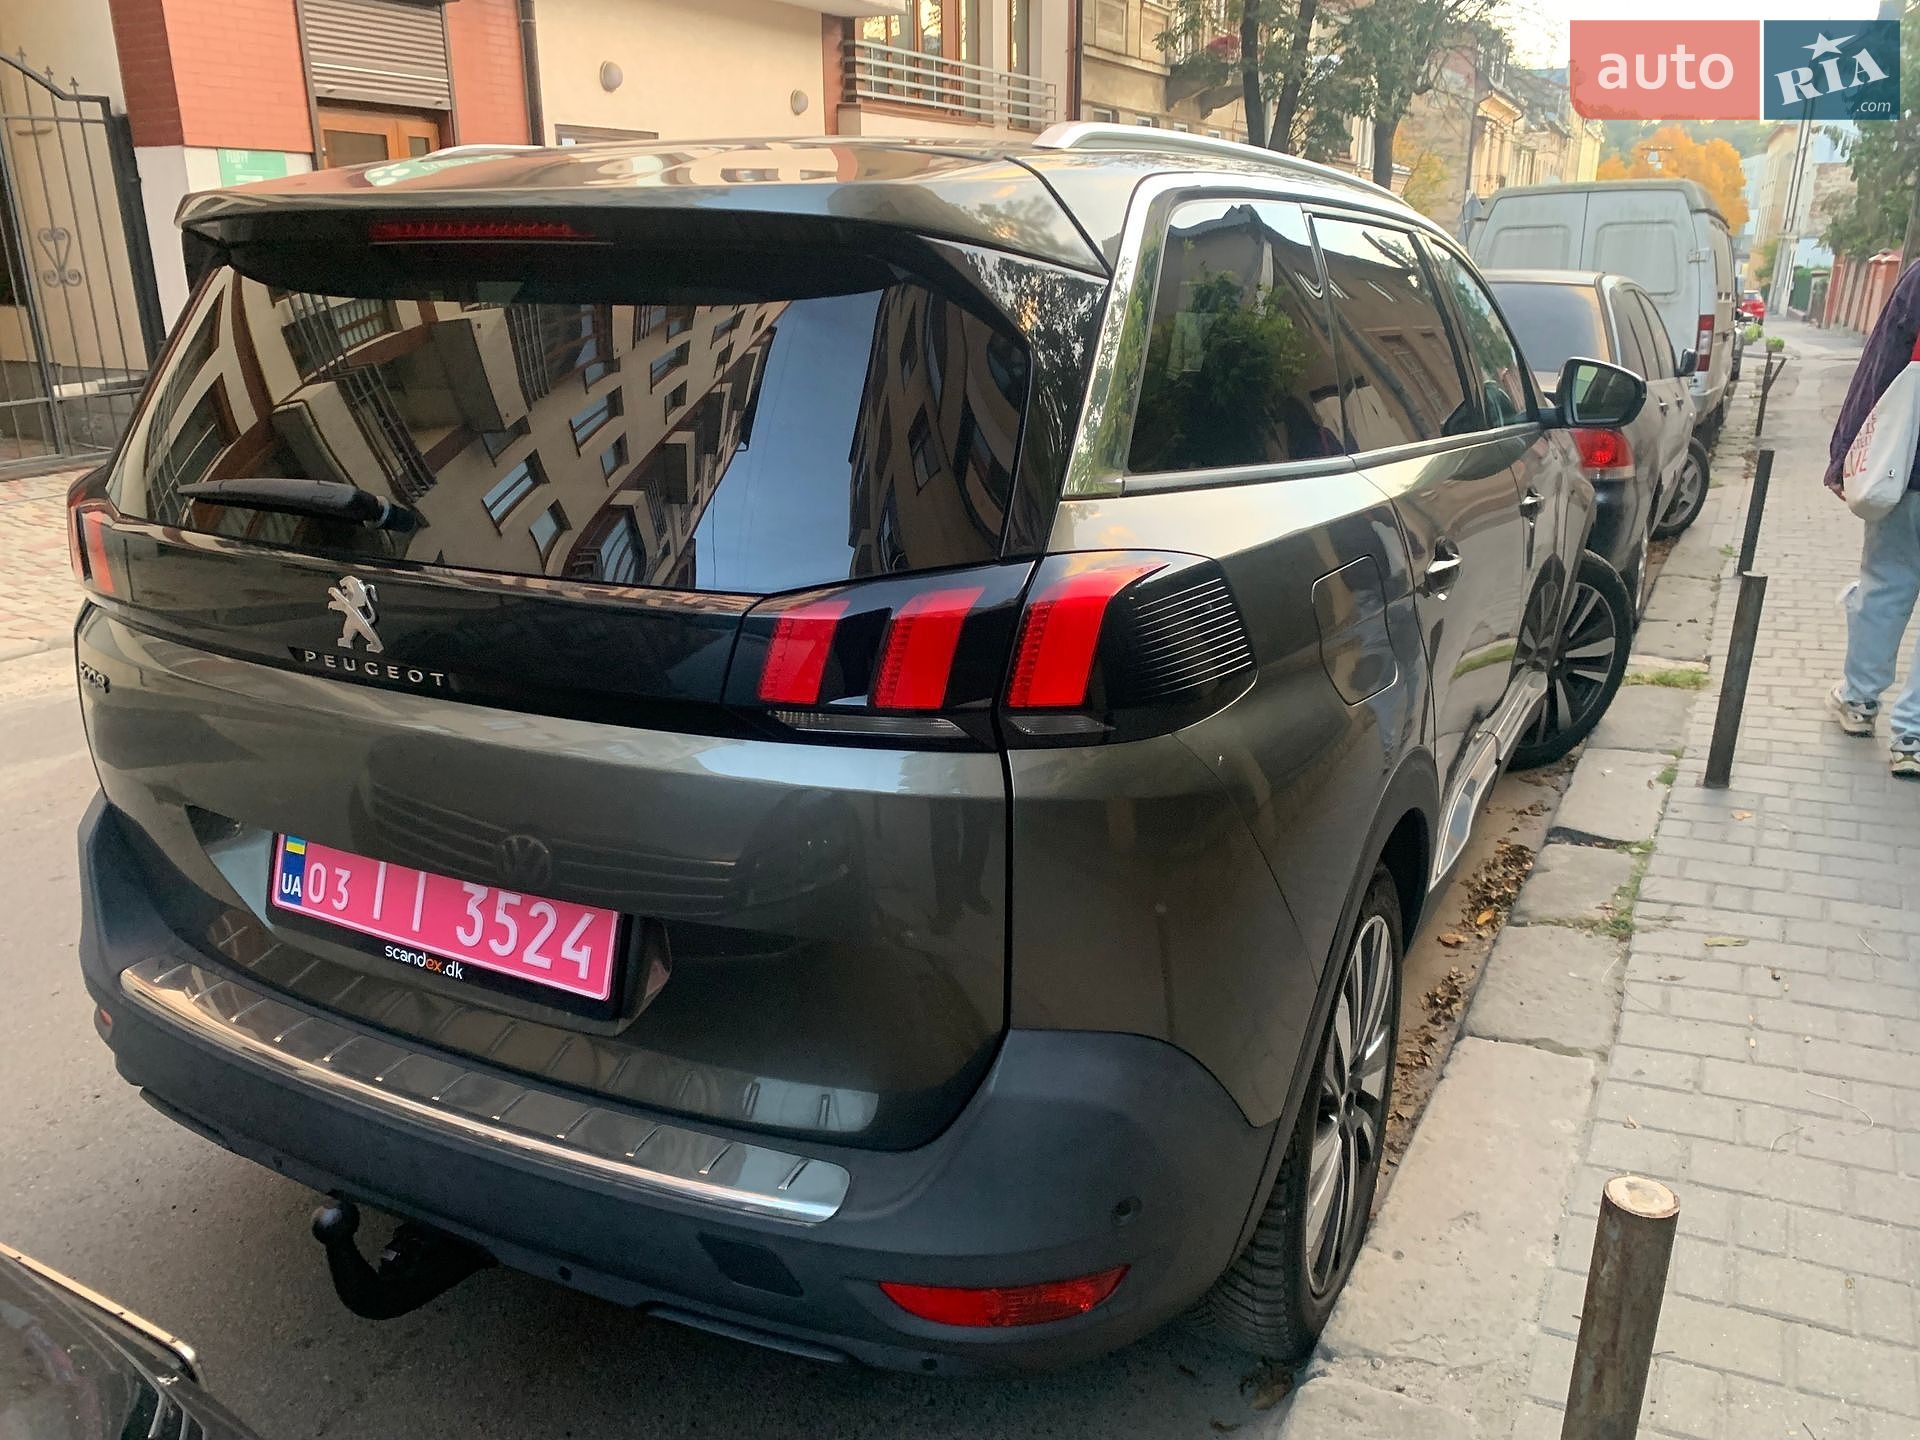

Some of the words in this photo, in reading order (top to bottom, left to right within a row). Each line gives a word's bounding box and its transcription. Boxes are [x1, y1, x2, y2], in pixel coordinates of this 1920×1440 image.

[304, 650, 445, 687] PEUGEOT
[281, 872, 302, 898] UA
[455, 881, 597, 980] 3524
[384, 945, 463, 980] scandex.dk
